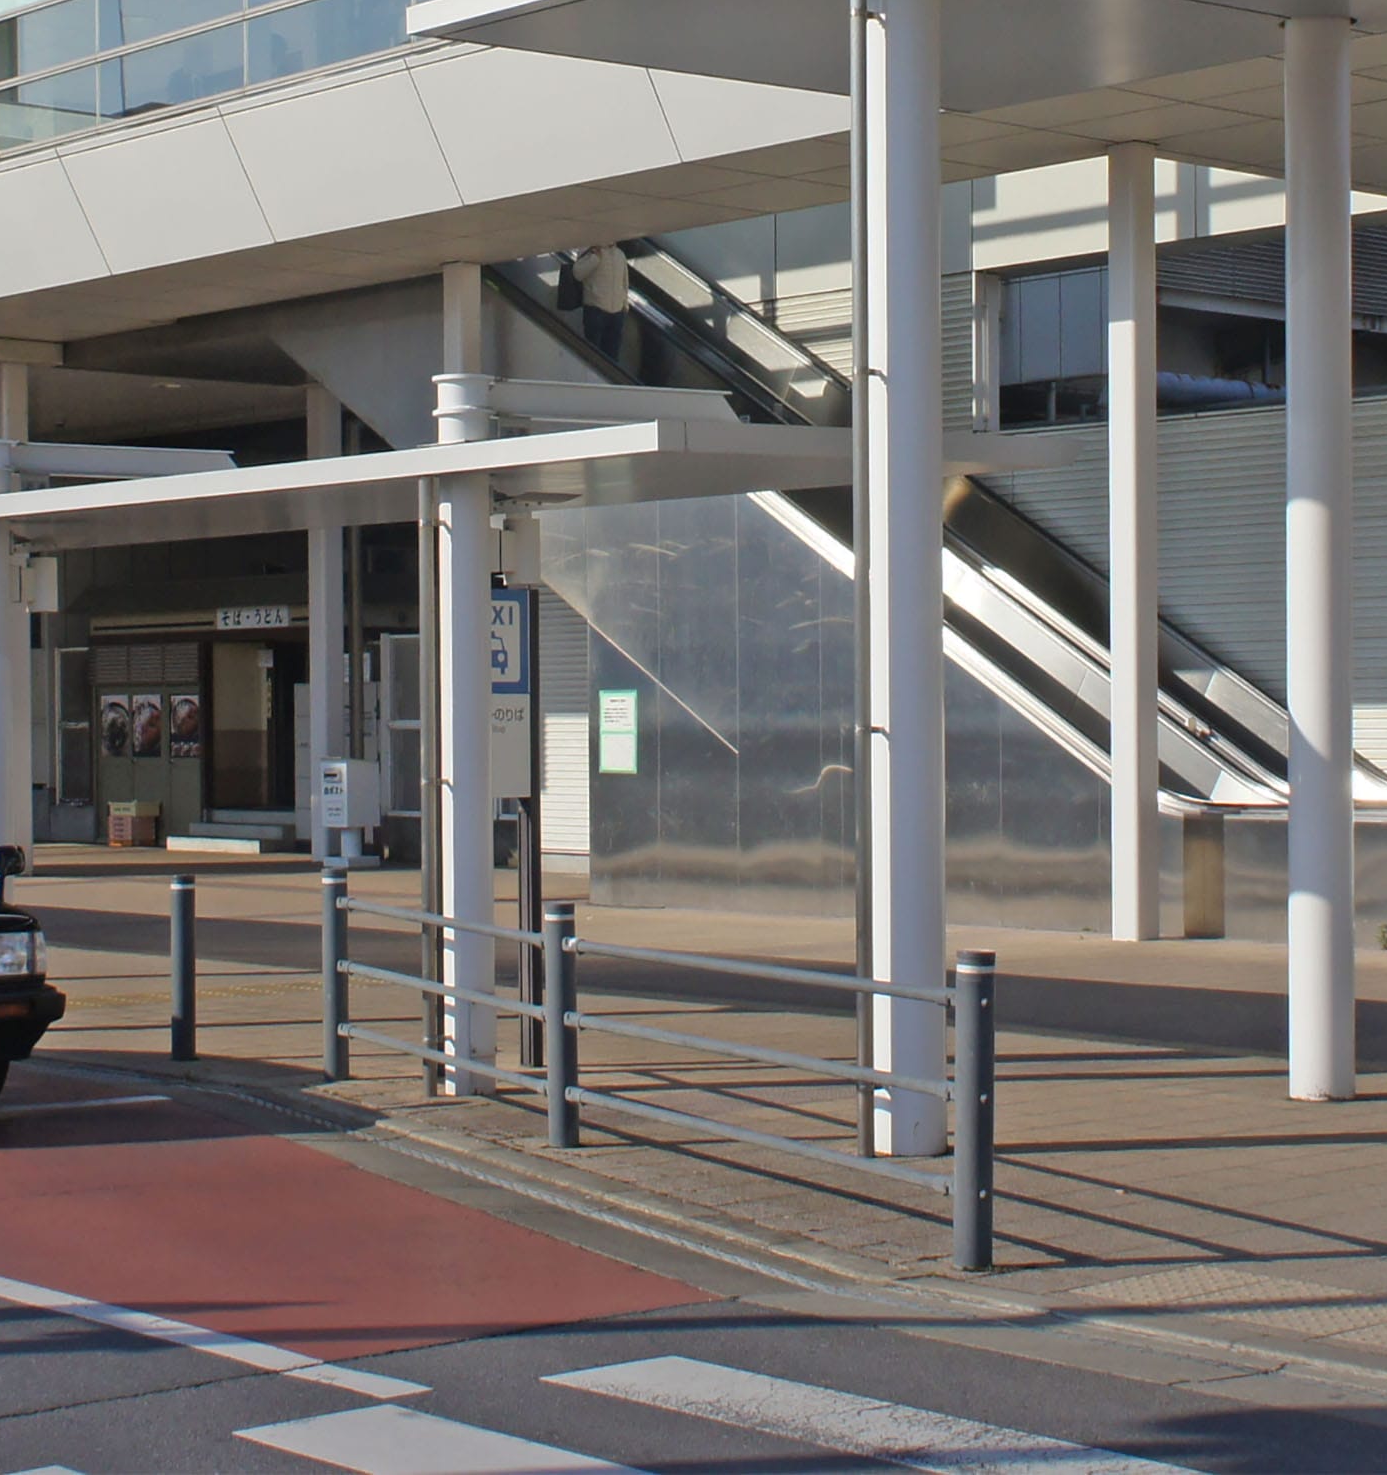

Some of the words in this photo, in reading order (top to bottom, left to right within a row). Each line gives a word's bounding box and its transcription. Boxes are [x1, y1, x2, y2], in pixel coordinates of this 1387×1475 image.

[222, 608, 282, 626] そば・うどん
[492, 606, 513, 625] XI
